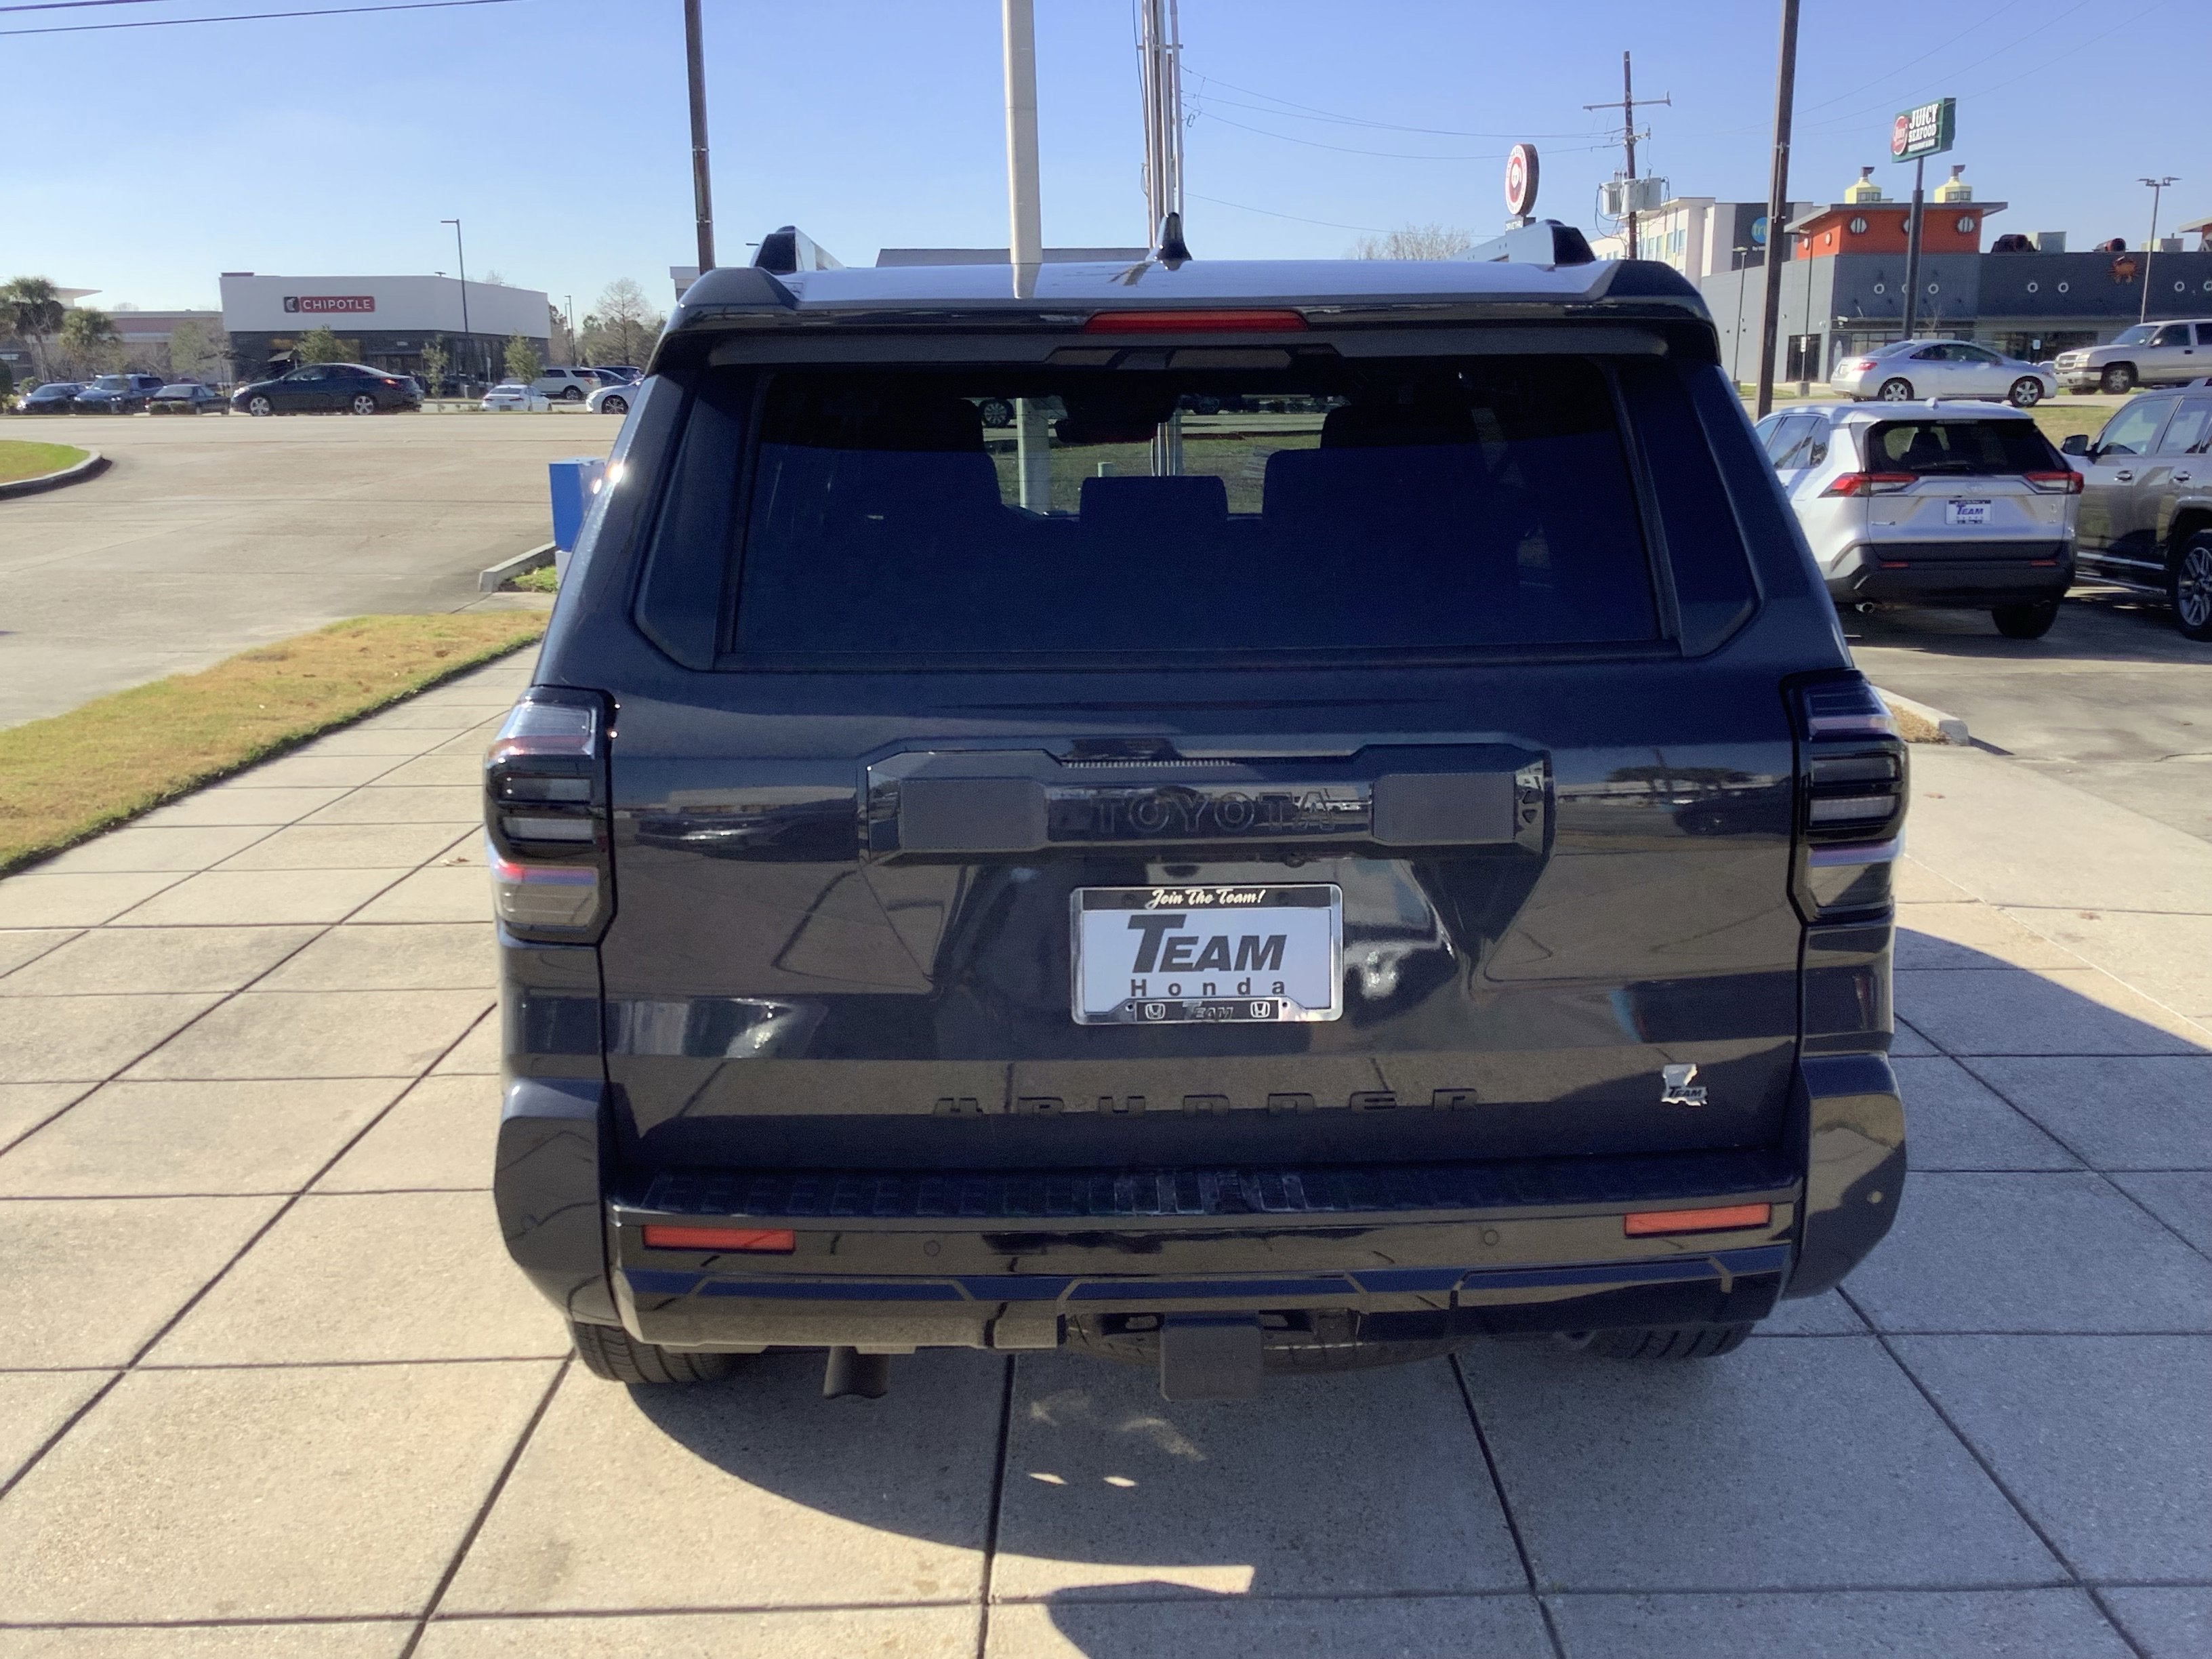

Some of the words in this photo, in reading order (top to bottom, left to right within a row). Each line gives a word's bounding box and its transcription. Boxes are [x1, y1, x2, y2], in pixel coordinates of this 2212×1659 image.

[1909, 103, 1938, 129] JUICY
[1908, 123, 1937, 143] SEAFOOD
[303, 299, 371, 310] CHIPOTLE
[1956, 502, 1984, 515] TEAM
[1090, 790, 1336, 833] TOYOTA
[1145, 888, 1184, 909] Join
[1185, 888, 1214, 905] The
[1216, 888, 1266, 905] Team!
[1127, 914, 1288, 973] TEAM
[1130, 977, 1286, 997] Honda
[1182, 1000, 1234, 1020] TEAM
[1669, 1086, 1702, 1098] TEAM
